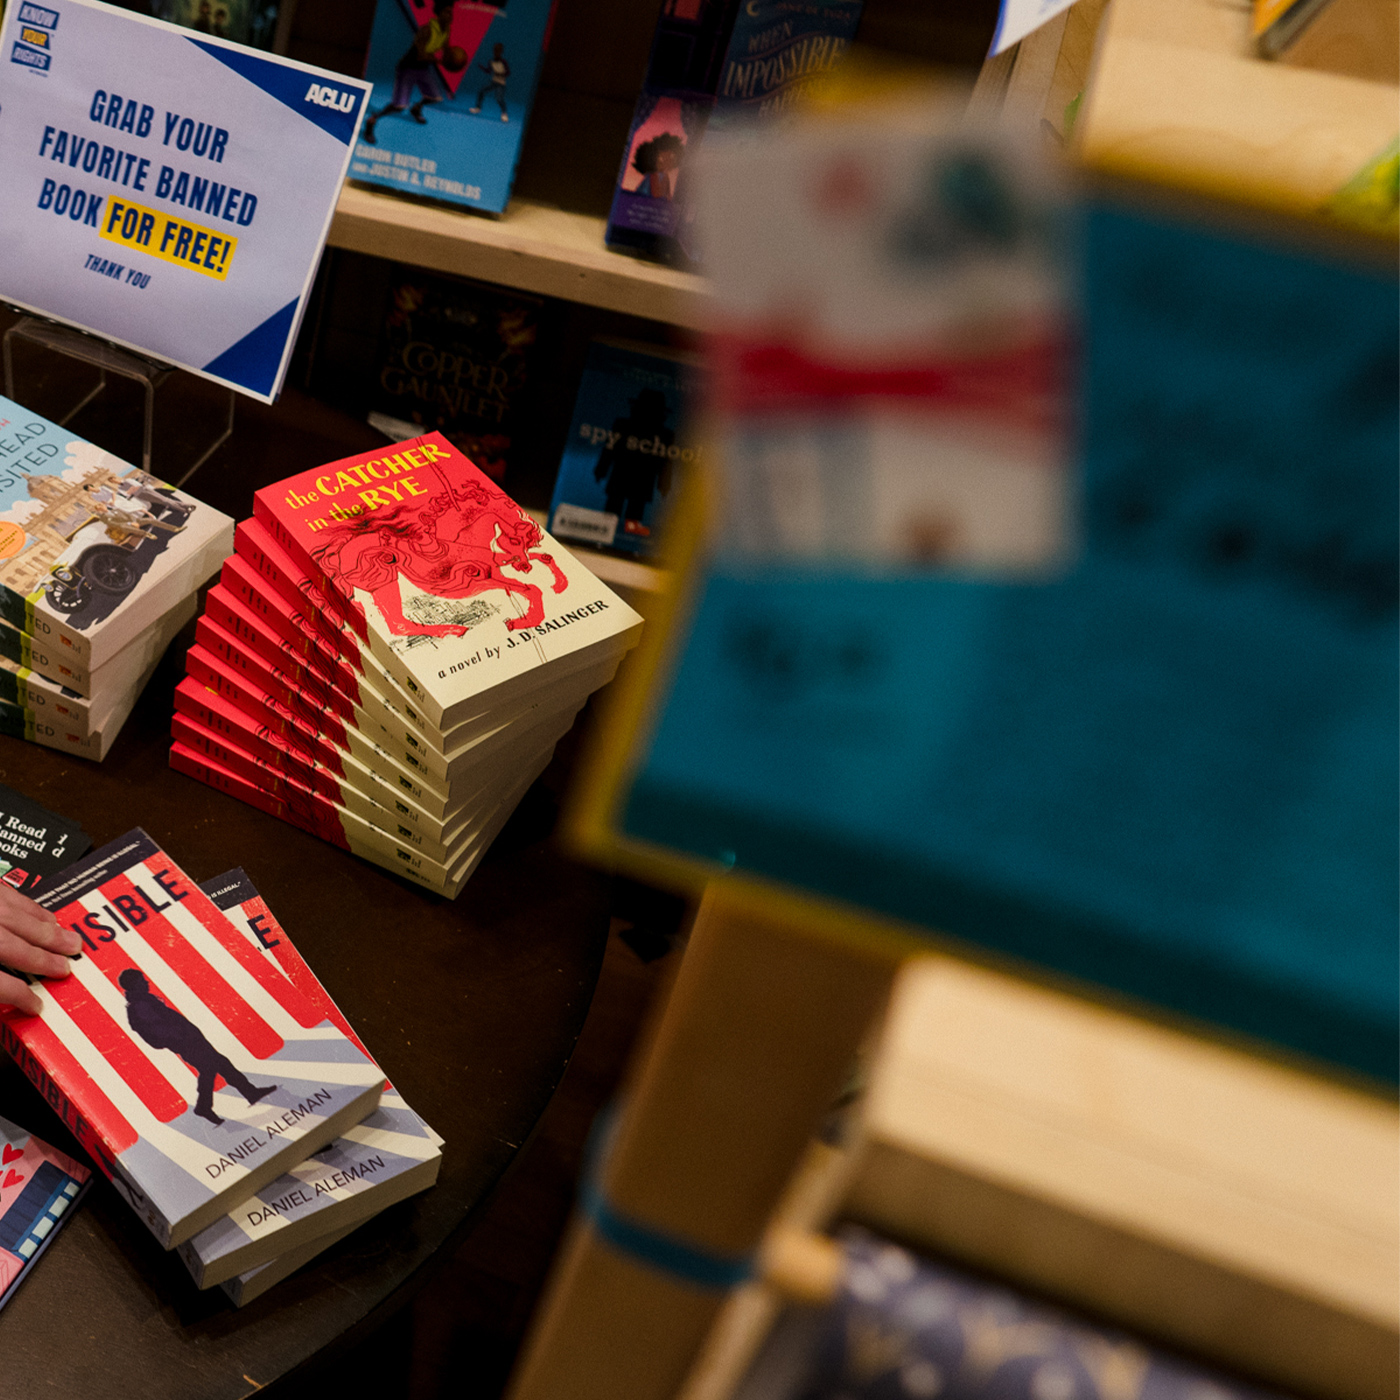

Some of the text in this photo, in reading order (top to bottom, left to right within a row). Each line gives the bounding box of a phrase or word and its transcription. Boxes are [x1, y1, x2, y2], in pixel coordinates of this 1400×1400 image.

[19, 6, 57, 27] KNOW
[22, 28, 48, 46] YOUR
[748, 20, 793, 53] WHEN
[13, 47, 48, 68] RIGHTS
[723, 35, 845, 97] IMPOSSIBLE
[89, 90, 230, 163] GRAB YOUR
[304, 83, 356, 114] ACLU
[39, 126, 258, 226] FAVORITE BANNED
[37, 178, 232, 273] BOOK FOR FREE!
[83, 254, 152, 289] THANK YOU
[380, 365, 510, 423] GAUNTLET
[401, 341, 509, 402] COPPER
[579, 423, 621, 450] spy
[284, 443, 451, 511] the CATCHER
[305, 476, 428, 532] in the RYE
[438, 600, 610, 679] a novel by J. D. SALINGER
[5, 815, 48, 840] Read
[69, 869, 190, 957] ISIBLE
[211, 891, 218, 899] IS
[205, 1087, 333, 1179] DANIEL ALEMAN
[246, 1155, 386, 1227] DANIEL ALEMAN
